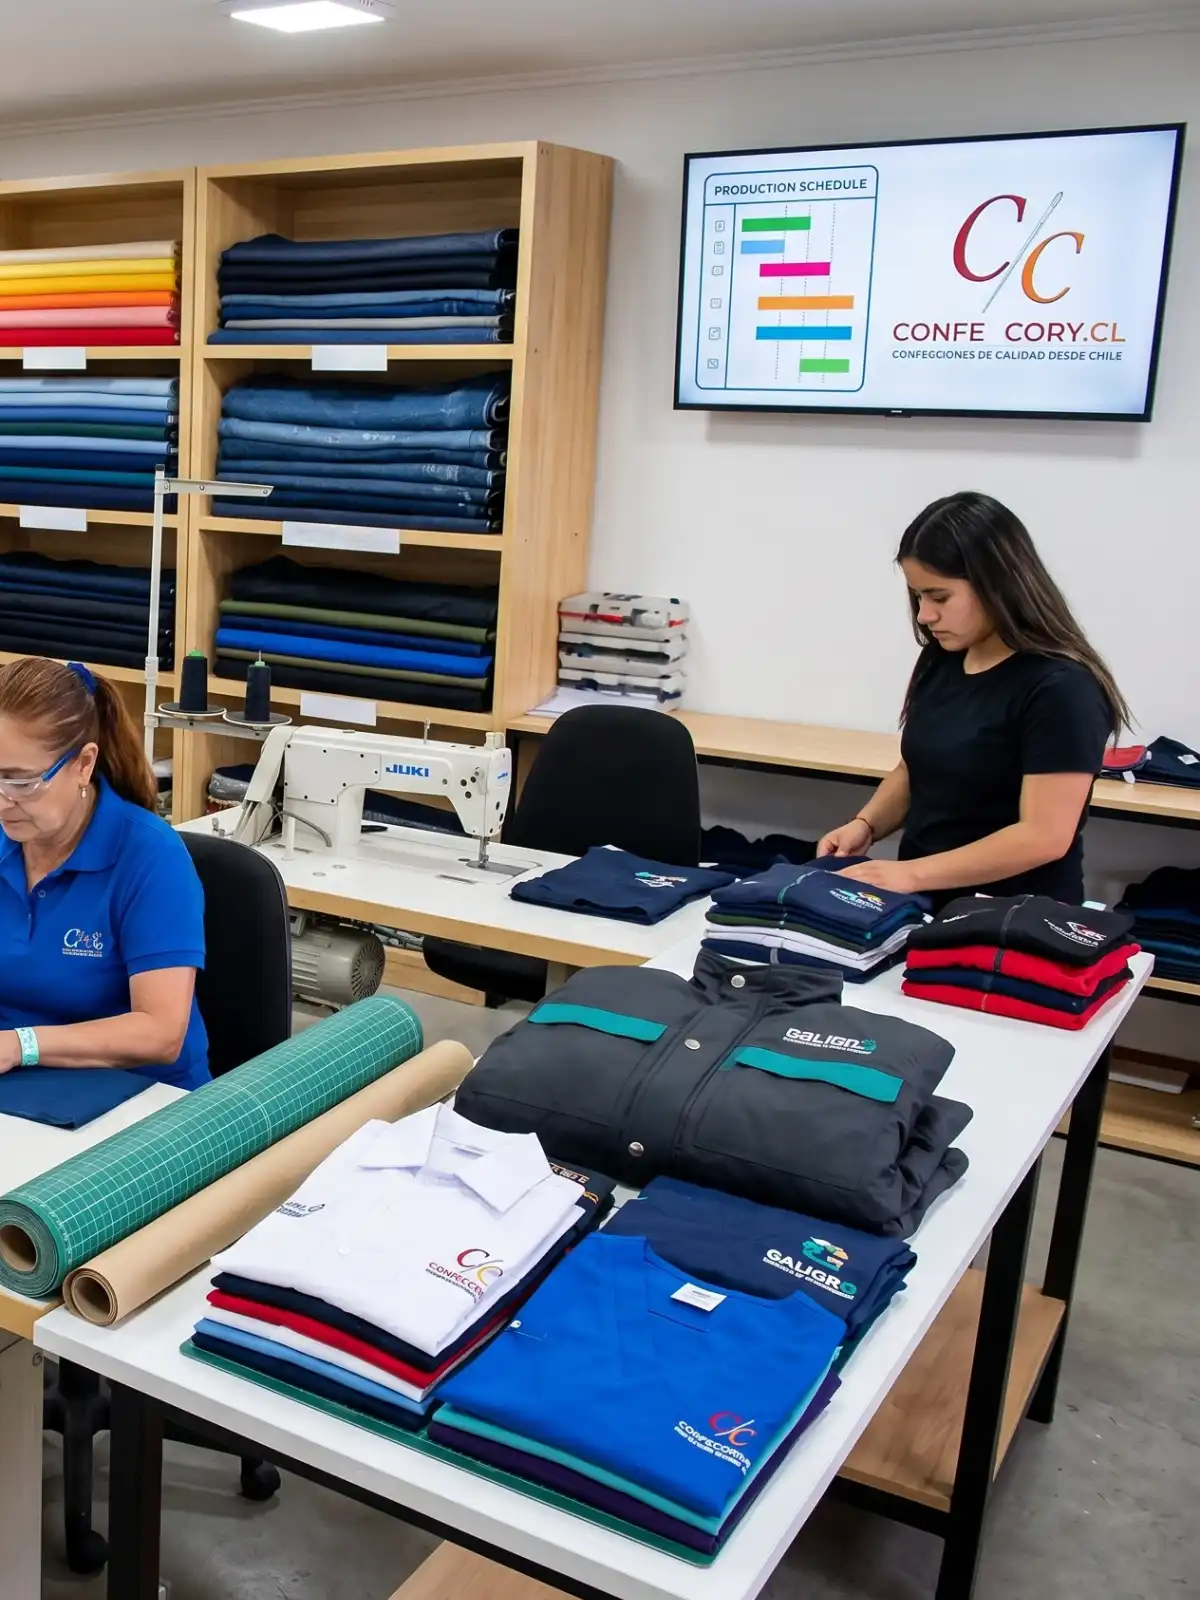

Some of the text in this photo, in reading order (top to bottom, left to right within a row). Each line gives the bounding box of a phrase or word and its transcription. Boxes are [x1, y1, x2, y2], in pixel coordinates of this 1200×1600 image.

[714, 178, 868, 196] PRODUCTION SCHEDULE
[892, 322, 1126, 343] CONFE CORY.CL
[978, 350, 993, 360] DE
[995, 350, 1046, 360] CALIDAD
[1048, 351, 1086, 360] DESDE
[1088, 351, 1123, 361] CHILE
[385, 764, 430, 778] JUKI
